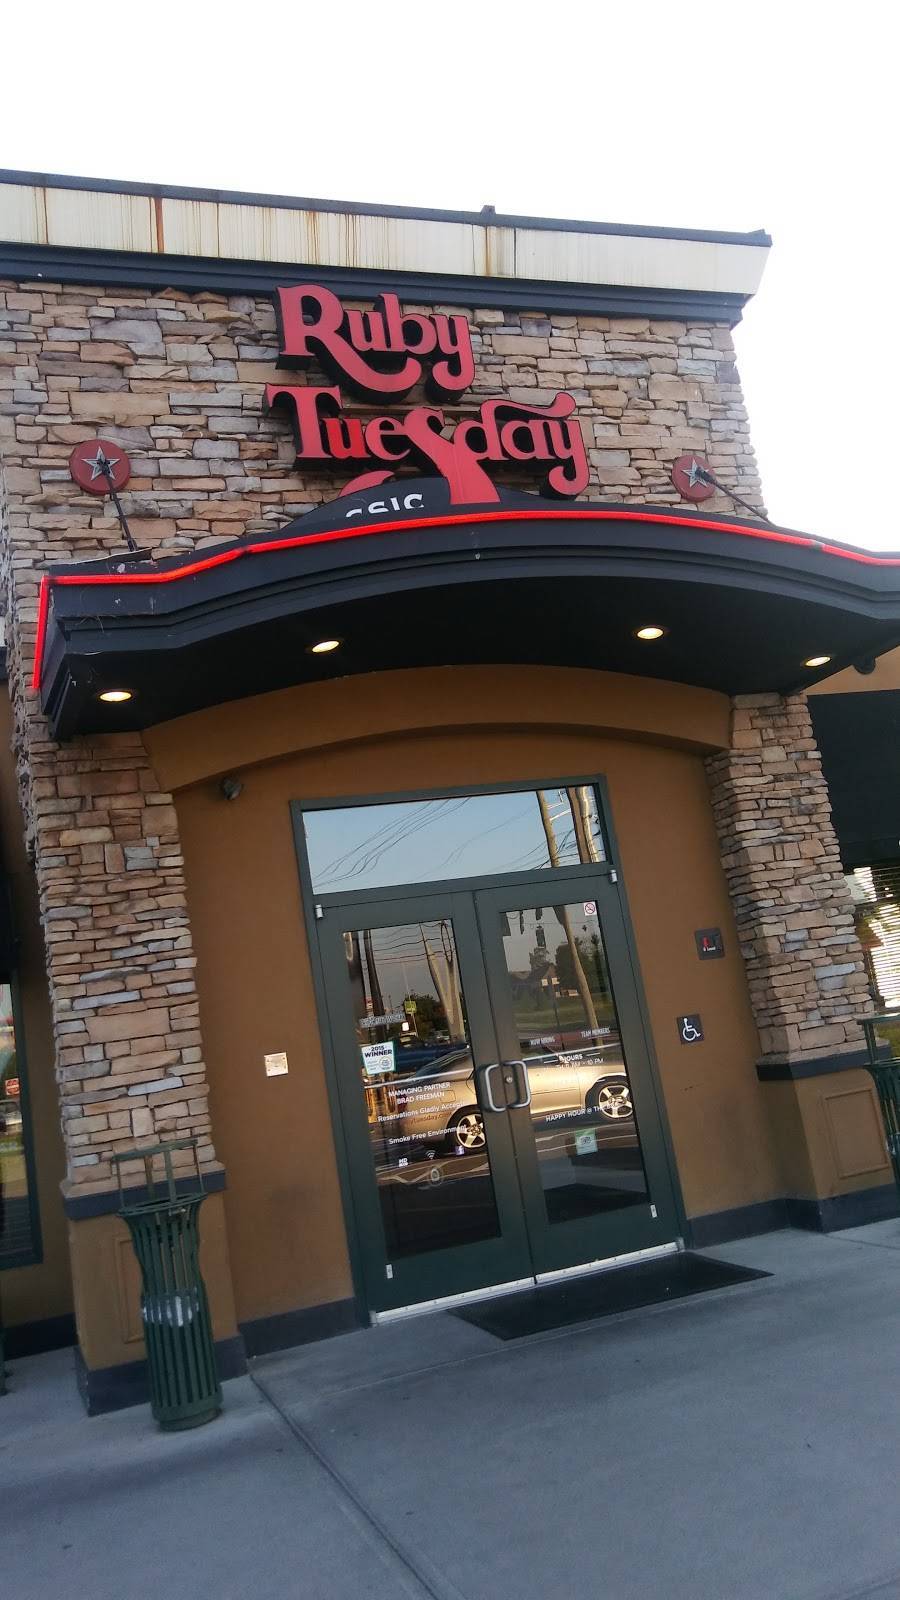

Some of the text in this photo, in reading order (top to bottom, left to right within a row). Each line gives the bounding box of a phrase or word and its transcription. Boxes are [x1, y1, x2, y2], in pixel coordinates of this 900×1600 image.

[276, 284, 476, 394] Ruby
[265, 383, 591, 504] Tuesday
[364, 1050, 393, 1058] WINNER
[388, 1082, 451, 1097] MANAGING PARTNER
[397, 1091, 445, 1105] BRAD FREEMAN
[377, 1108, 419, 1122] Reservations
[419, 1104, 440, 1115] Gladly
[441, 1101, 470, 1111] Accep
[546, 1112, 566, 1122] HAPPY
[567, 1108, 586, 1118] HOUR
[388, 1135, 411, 1145] Smoke
[411, 1132, 427, 1141] Free
